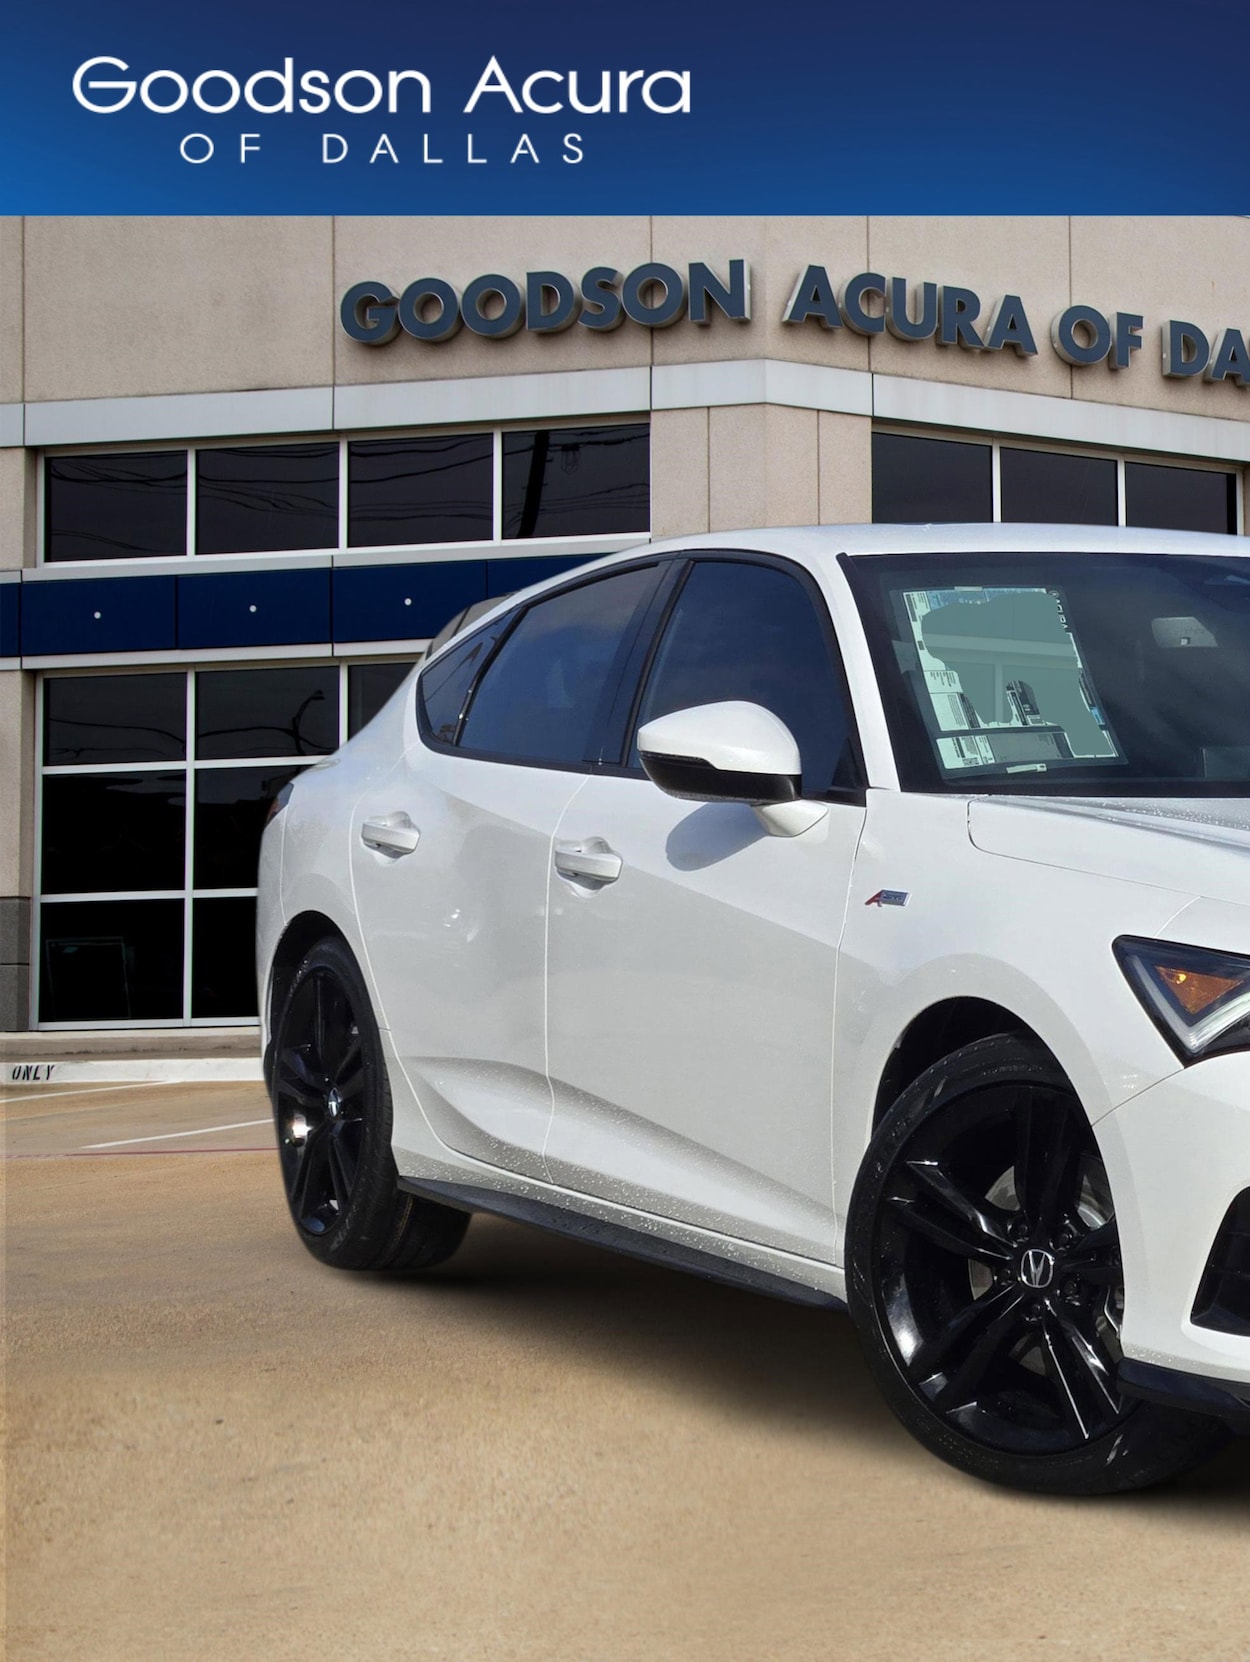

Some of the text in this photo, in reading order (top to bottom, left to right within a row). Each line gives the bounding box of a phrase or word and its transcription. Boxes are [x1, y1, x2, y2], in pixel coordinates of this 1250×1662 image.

[340, 259, 752, 346] GOODSON
[783, 264, 1039, 357] ACURA
[1050, 304, 1144, 370] OF
[12, 1064, 55, 1081] ONLY
